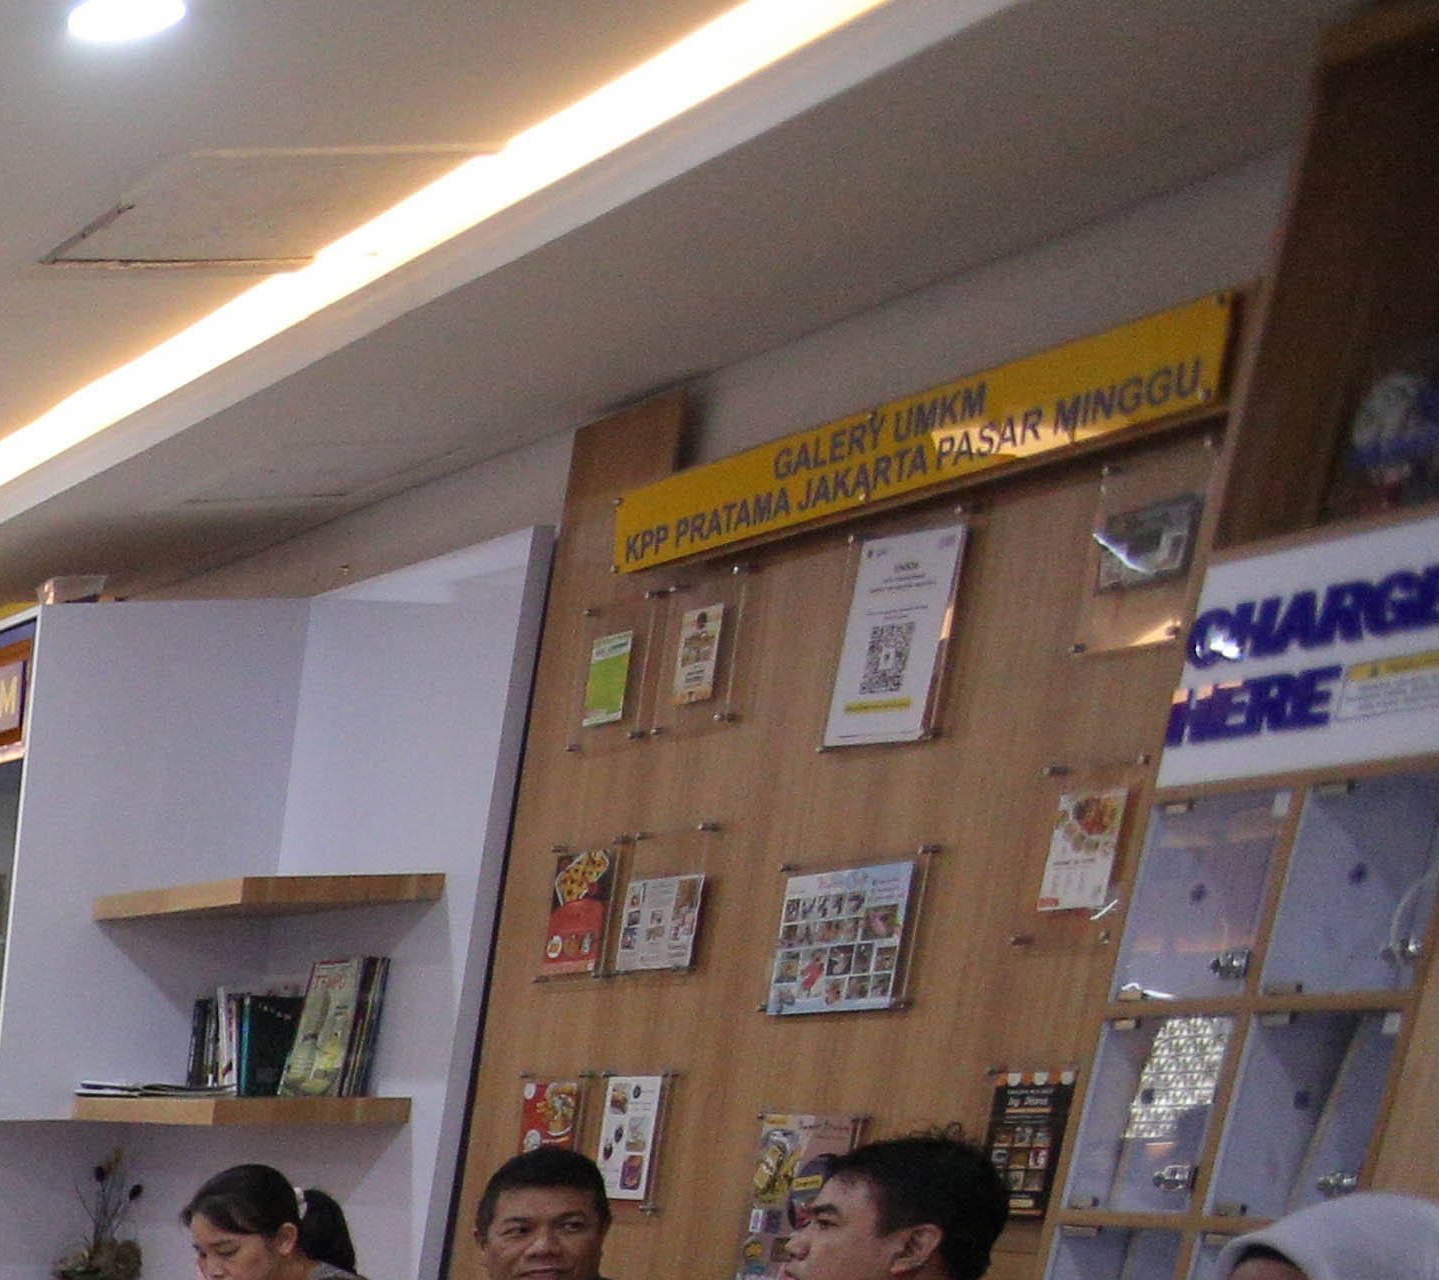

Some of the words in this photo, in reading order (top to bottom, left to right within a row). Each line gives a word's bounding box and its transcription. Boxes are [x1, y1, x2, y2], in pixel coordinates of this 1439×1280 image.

[773, 411, 881, 480] GALERY
[892, 381, 988, 444] UMKM
[625, 526, 669, 563] KPP
[674, 494, 791, 549] PRATAMA
[797, 454, 928, 514] JAKARTA
[934, 406, 1042, 473] PASAR
[1165, 664, 1342, 749] HERE
